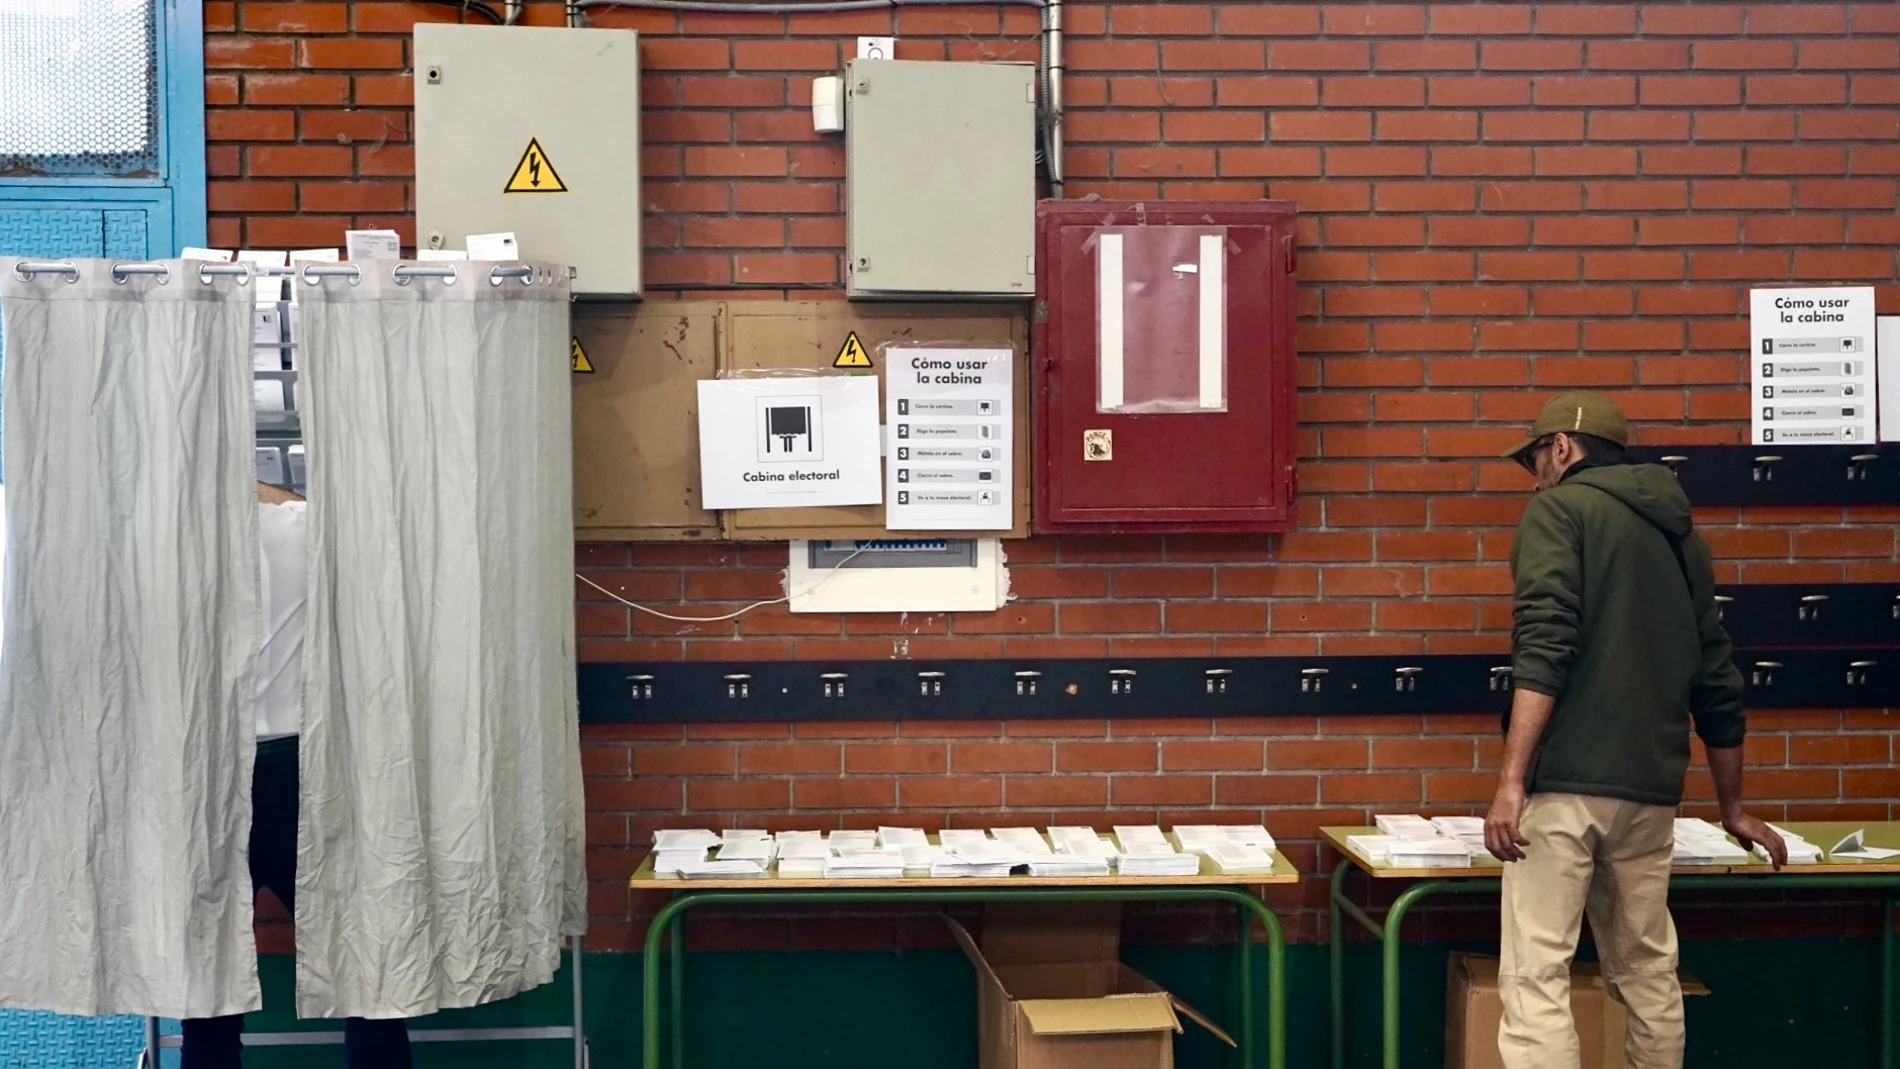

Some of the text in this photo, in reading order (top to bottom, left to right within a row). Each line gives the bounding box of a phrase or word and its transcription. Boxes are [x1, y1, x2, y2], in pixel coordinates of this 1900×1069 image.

[1775, 297, 1850, 309] Cómo usar
[1780, 310, 1844, 323] la cabina
[1765, 342, 1769, 351] 1
[911, 357, 988, 369] Cómo usar
[1764, 365, 1771, 374] 2
[917, 371, 982, 384] la cabina
[1764, 387, 1772, 396] 3
[900, 402, 905, 411] 1
[1764, 409, 1771, 418] 4
[900, 426, 907, 435] 2
[1765, 431, 1771, 440] 5
[900, 449, 907, 458] 3
[743, 469, 840, 482] Cabina electoral
[899, 471, 907, 480] 4
[900, 493, 907, 502] 5
